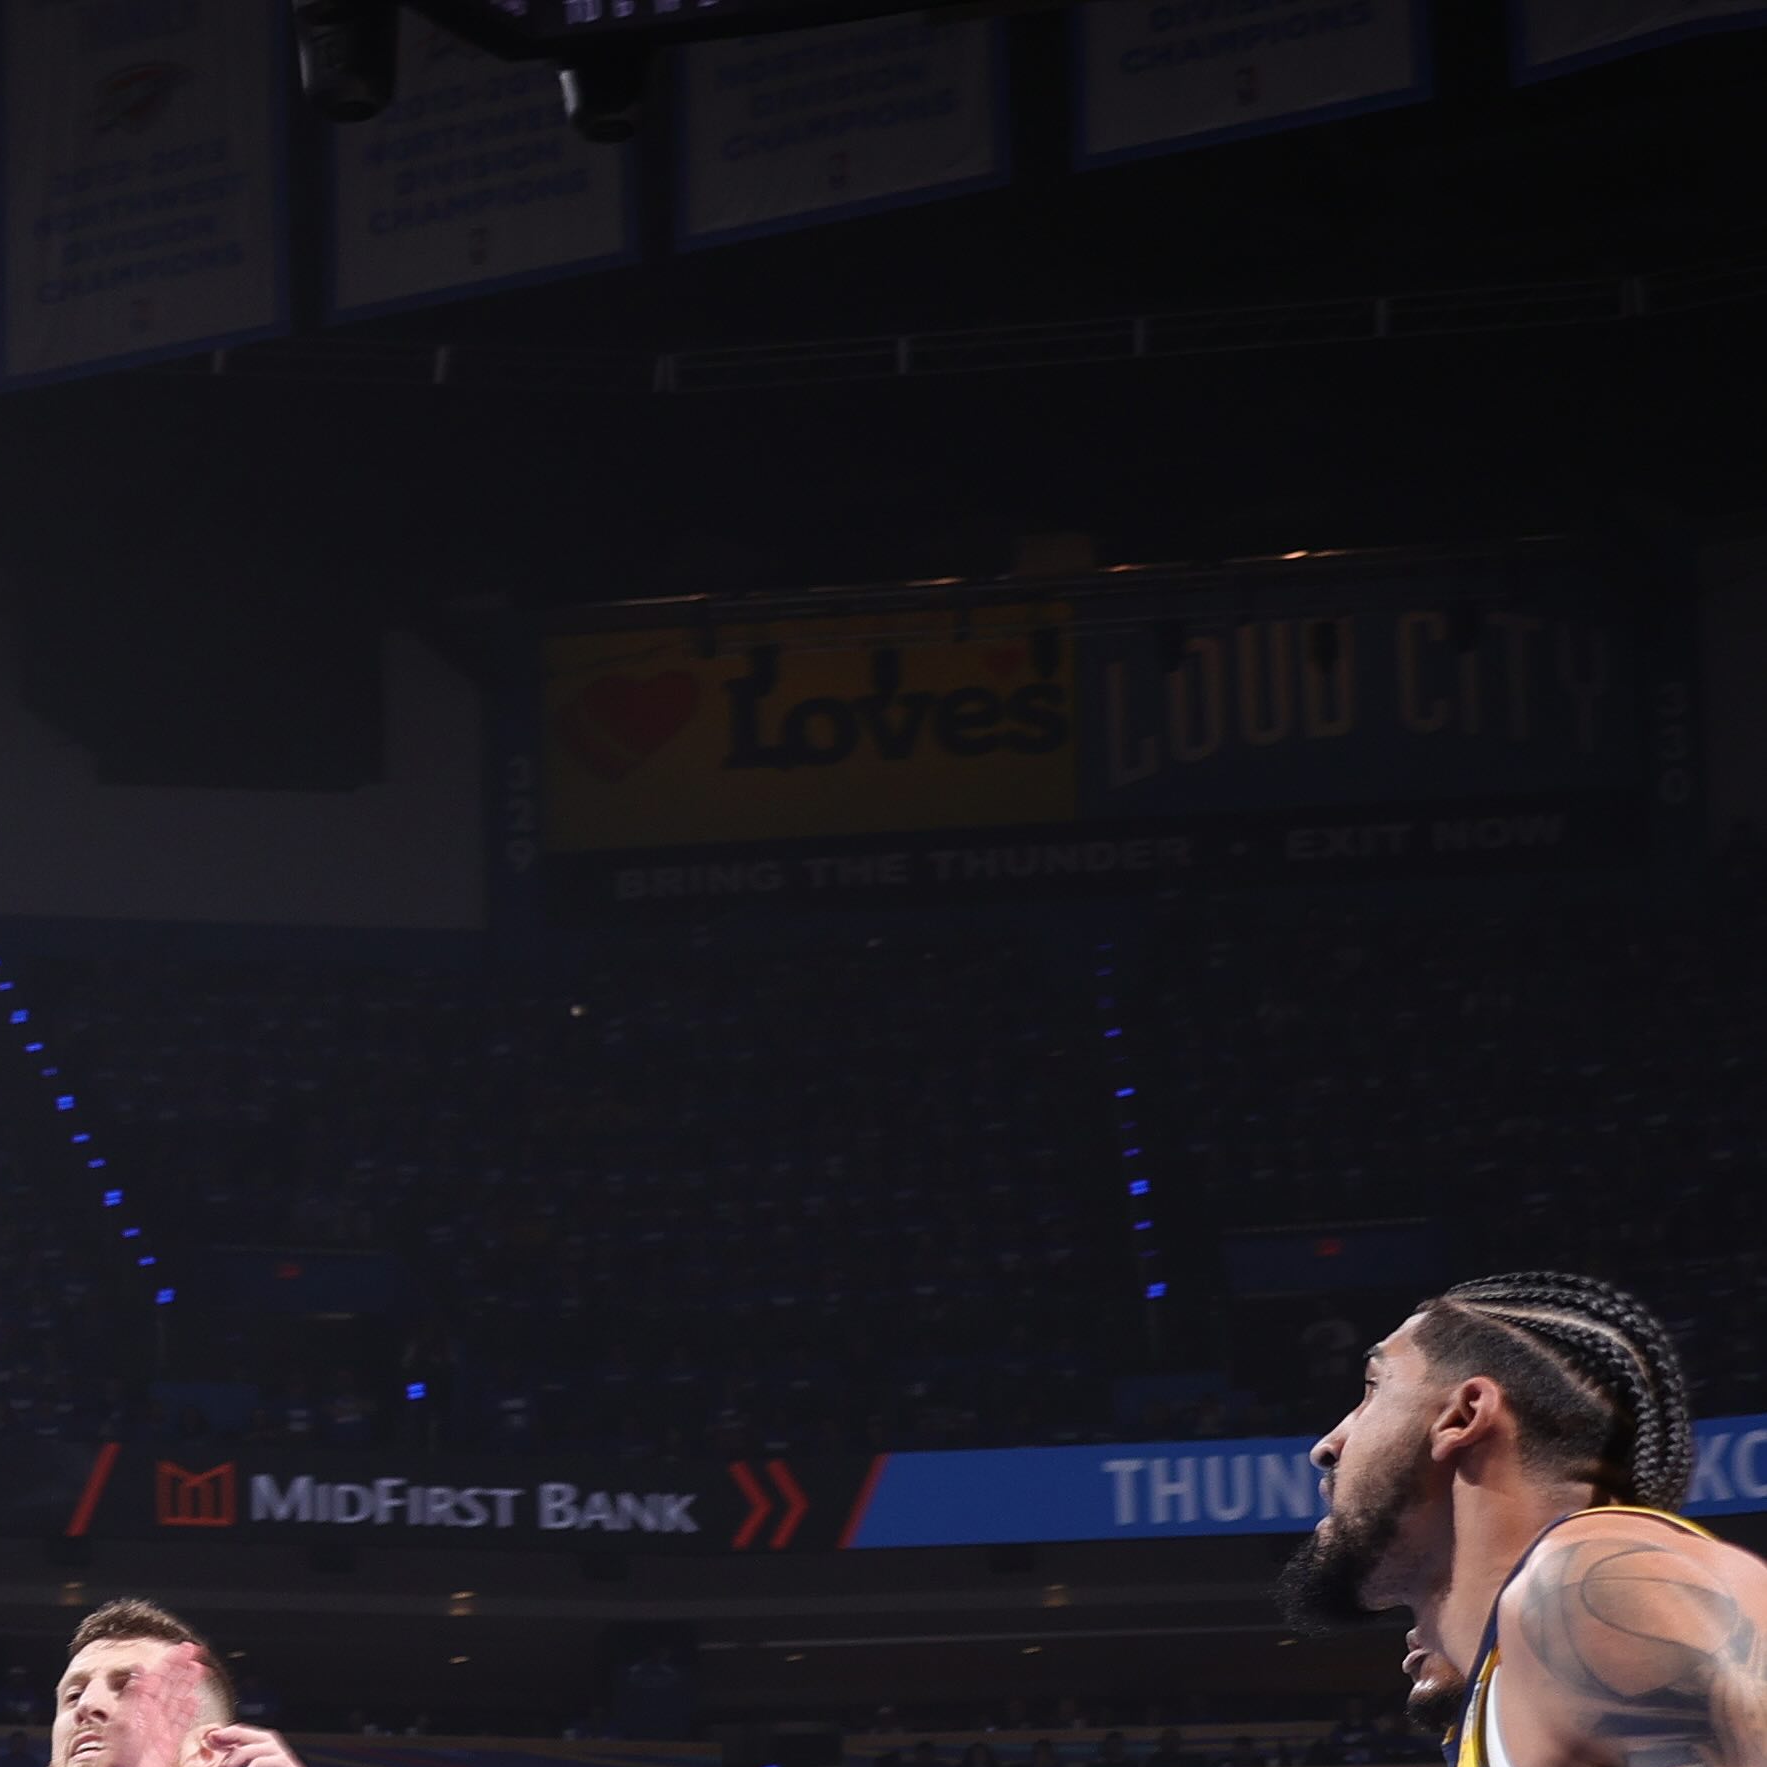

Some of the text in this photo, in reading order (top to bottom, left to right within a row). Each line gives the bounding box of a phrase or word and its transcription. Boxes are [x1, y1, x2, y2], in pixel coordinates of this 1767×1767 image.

[1119, 2, 1373, 73] CHAMPIONS
[362, 102, 569, 168] NORTHWES
[722, 87, 958, 160] CHAMPIONS
[369, 167, 588, 235] CHAMPIONS
[1396, 609, 1609, 753] CITY
[615, 811, 1568, 901] BRING THE THUNDER EXIT NOW
[1100, 1452, 1317, 1527] THUN
[1688, 1428, 1767, 1503] KC
